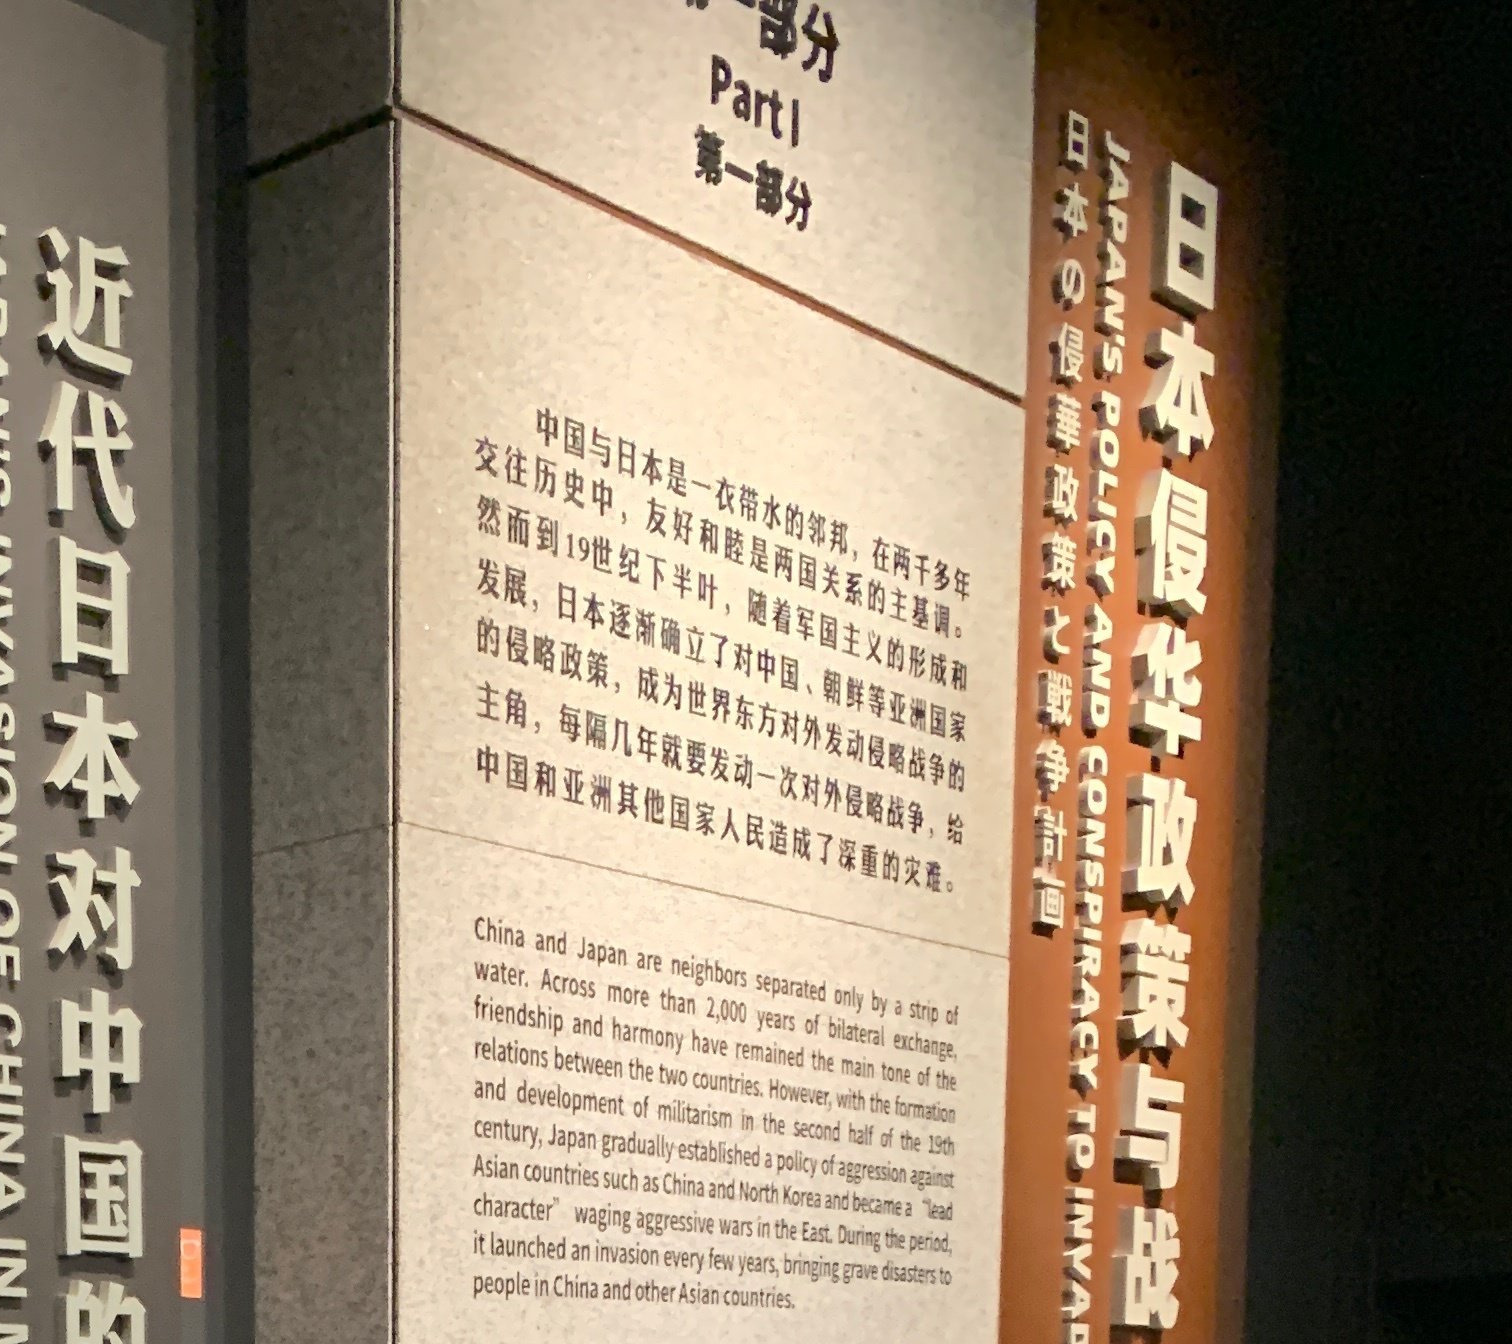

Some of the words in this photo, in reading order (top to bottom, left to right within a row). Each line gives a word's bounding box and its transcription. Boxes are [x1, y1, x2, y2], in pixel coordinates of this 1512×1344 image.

[686, 0, 840, 83] 部分
[710, 53, 783, 140] Part
[693, 122, 813, 233] 第一部分
[1098, 130, 1131, 376] JAPAN'S
[1088, 390, 1122, 595] POLICY
[1085, 602, 1113, 731] AND
[1071, 745, 1108, 1091] CONSPIRACY
[473, 915, 526, 949] China
[534, 930, 568, 962] and
[576, 935, 629, 969] Japan
[636, 951, 663, 974] are
[670, 953, 748, 988] neighbors
[755, 973, 827, 1003] separated
[833, 985, 865, 1015] only
[871, 988, 889, 1019] by
[893, 999, 903, 1017] a
[908, 999, 939, 1028] strip
[945, 1004, 960, 1026] of
[473, 960, 529, 989] water.
[539, 967, 597, 1000] Across
[607, 984, 651, 1009] more
[659, 986, 697, 1016] than
[705, 995, 748, 1025] 2,000
[755, 1009, 796, 1033] years
[803, 1012, 822, 1036] of
[827, 1015, 886, 1047] bilateral
[892, 1031, 958, 1063] exchange,
[472, 993, 564, 1039] friendship
[571, 1013, 604, 1039] and
[611, 1015, 685, 1057] harmony
[691, 1028, 729, 1057] have
[735, 1040, 805, 1069] remained
[809, 1048, 835, 1073] the
[840, 1055, 875, 1079] main
[880, 1061, 911, 1085] tone
[916, 1065, 932, 1087] of
[935, 1068, 958, 1092] the
[474, 1035, 549, 1070] relations
[553, 1044, 624, 1079] between
[627, 1056, 655, 1083] the
[658, 1062, 689, 1088] two
[691, 1071, 764, 1098] countries.
[768, 1077, 833, 1113] However,
[835, 1087, 867, 1112] with
[869, 1091, 891, 1116] the
[894, 1094, 957, 1124] formation
[1068, 1104, 1096, 1170] TO
[472, 1270, 531, 1302] people
[533, 1270, 550, 1299] in
[552, 1273, 600, 1300] China
[602, 1276, 632, 1301] and
[634, 1278, 677, 1304] other
[678, 1281, 721, 1307] Asian
[722, 1285, 797, 1310] countries.
